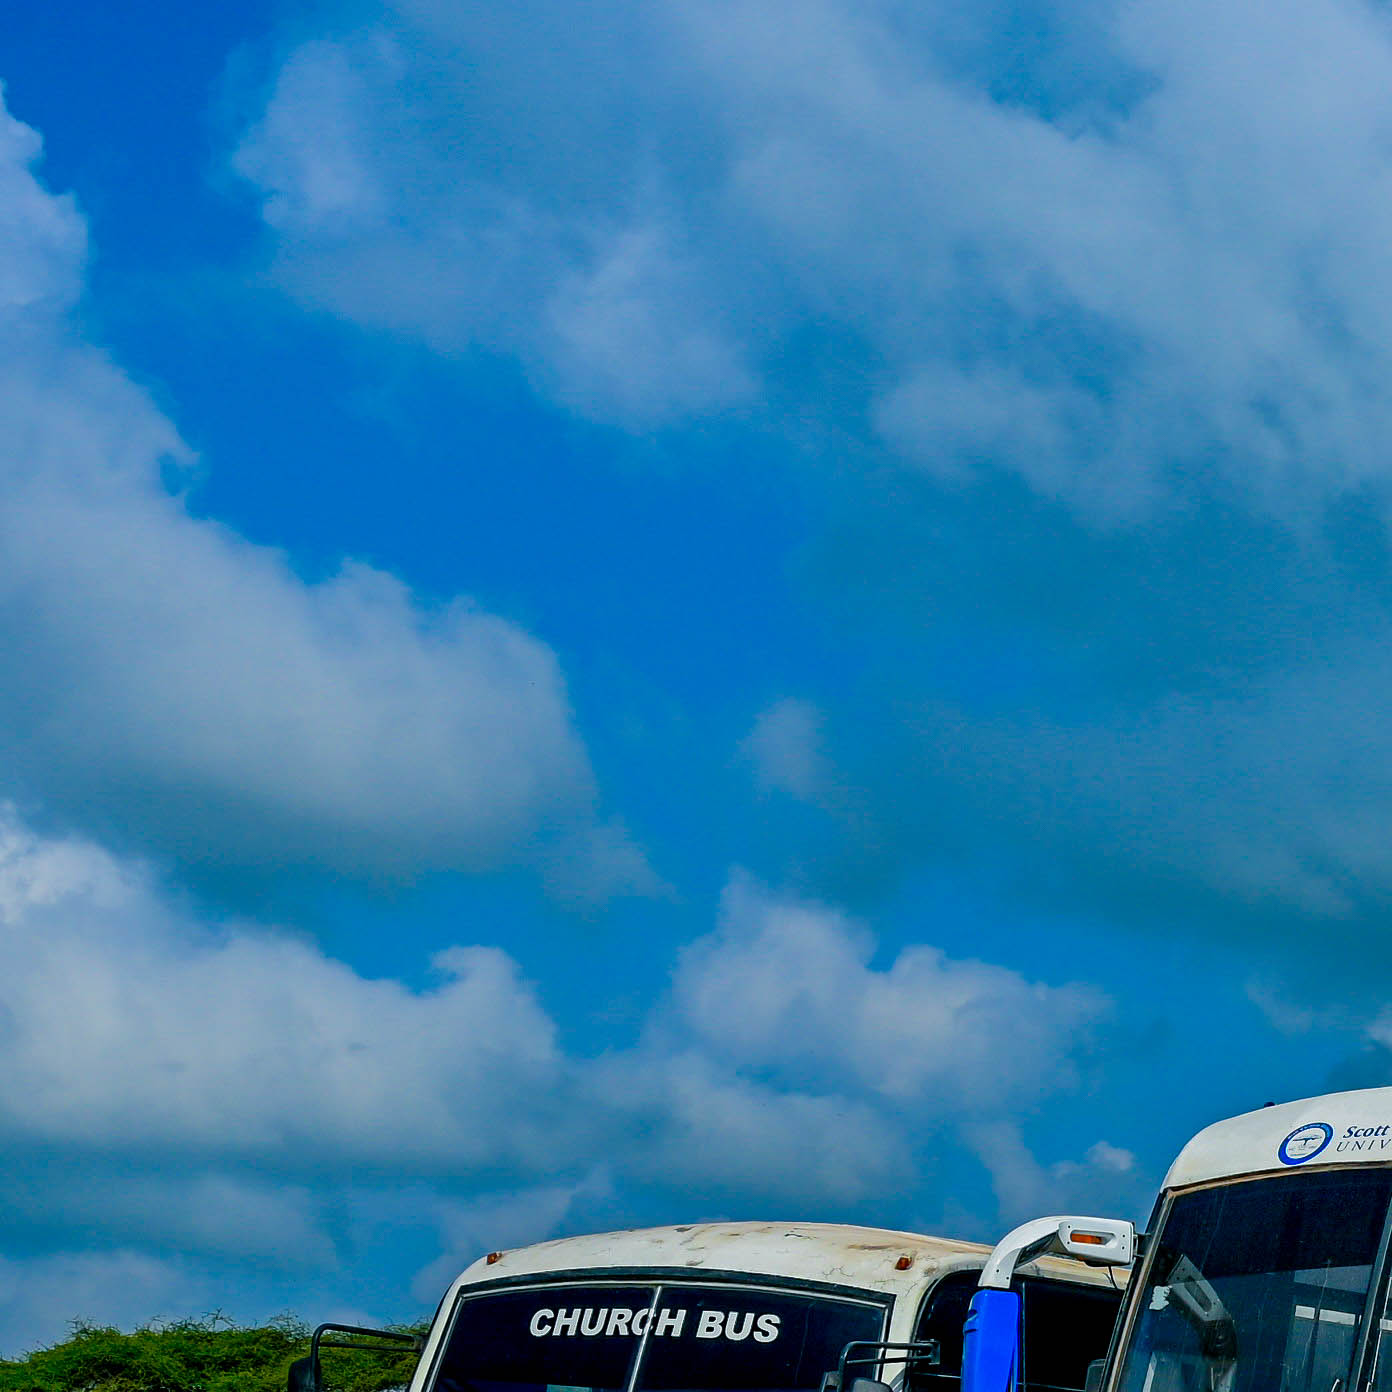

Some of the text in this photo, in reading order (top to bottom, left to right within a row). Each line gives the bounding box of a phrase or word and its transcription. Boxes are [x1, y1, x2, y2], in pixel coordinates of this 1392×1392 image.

[1343, 1125, 1391, 1139] Scott
[530, 1308, 781, 1343] CHURCH BUS
